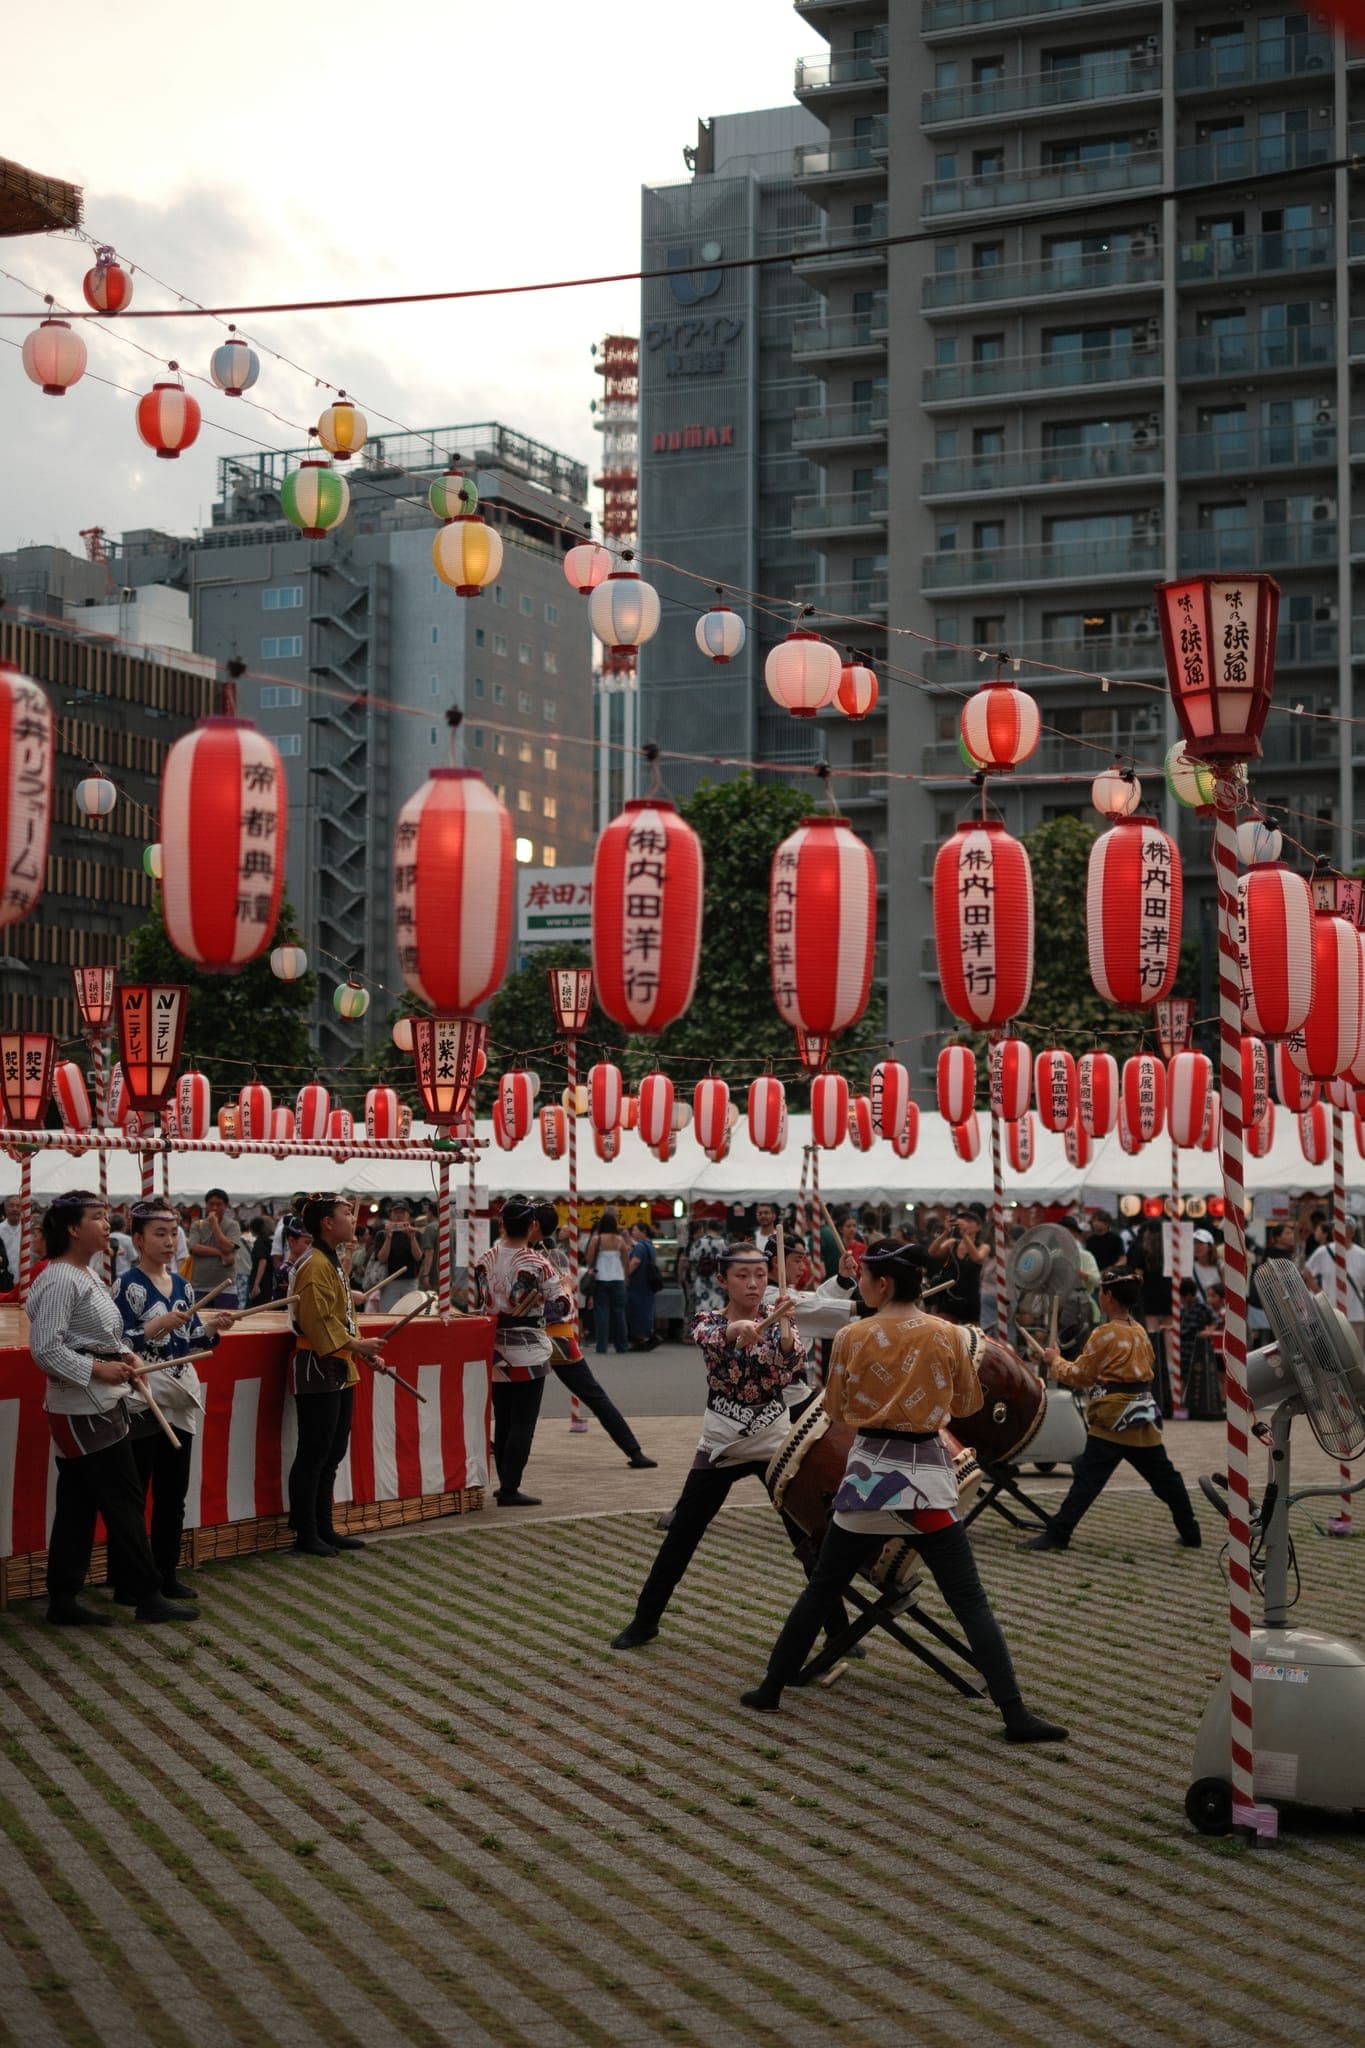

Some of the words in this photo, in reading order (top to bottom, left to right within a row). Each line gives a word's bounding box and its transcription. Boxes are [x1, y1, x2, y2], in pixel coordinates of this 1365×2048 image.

[5, 1051, 18, 1081] 紀文
[25, 1051, 42, 1081] 紀文
[437, 1039, 455, 1079] 紫水
[505, 1088, 514, 1124] APEX
[872, 1069, 884, 1129] APEX
